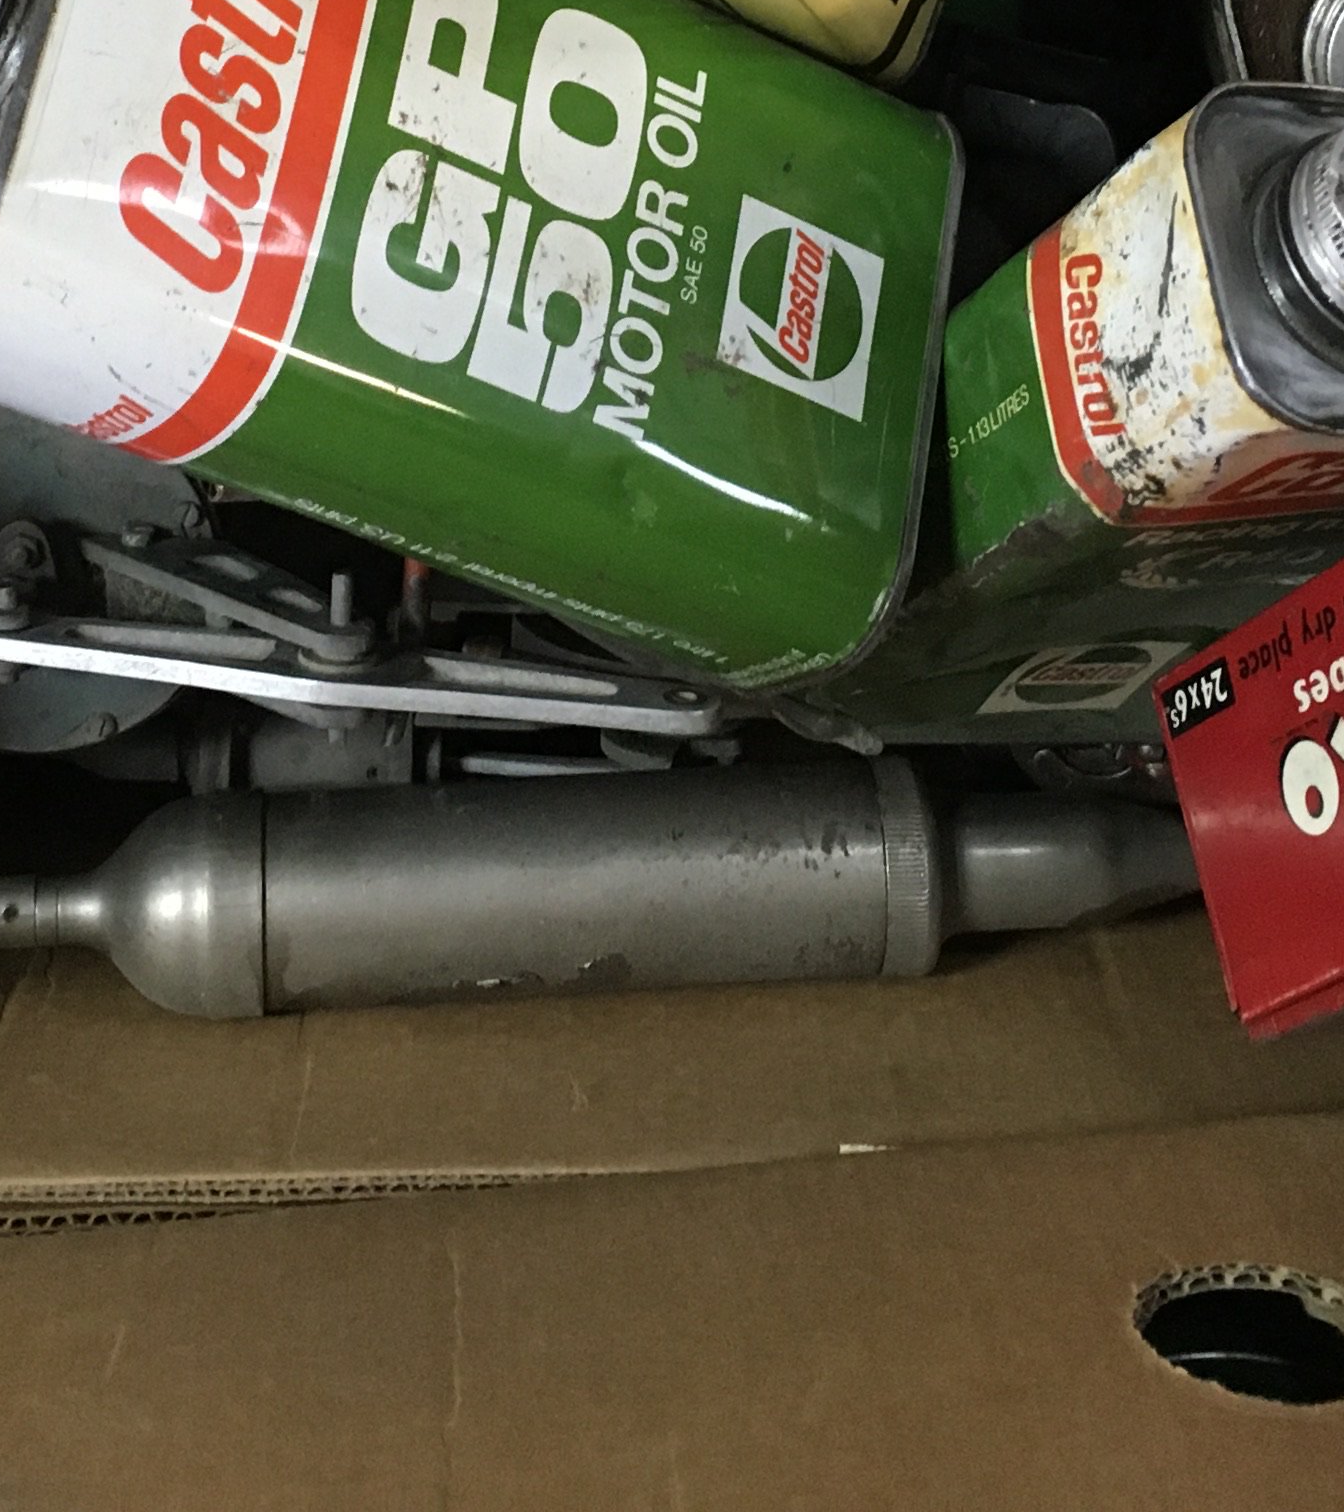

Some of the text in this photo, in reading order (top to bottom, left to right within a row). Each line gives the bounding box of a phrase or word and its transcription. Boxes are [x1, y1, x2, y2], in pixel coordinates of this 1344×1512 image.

[466, 8, 648, 413] 50
[592, 70, 708, 441] MOTOR OIL
[680, 224, 709, 305] SAE 50
[777, 228, 825, 366] Castrol
[1065, 252, 1130, 437] Castrol
[1237, 620, 1293, 680] place
[1301, 608, 1337, 644] dry
